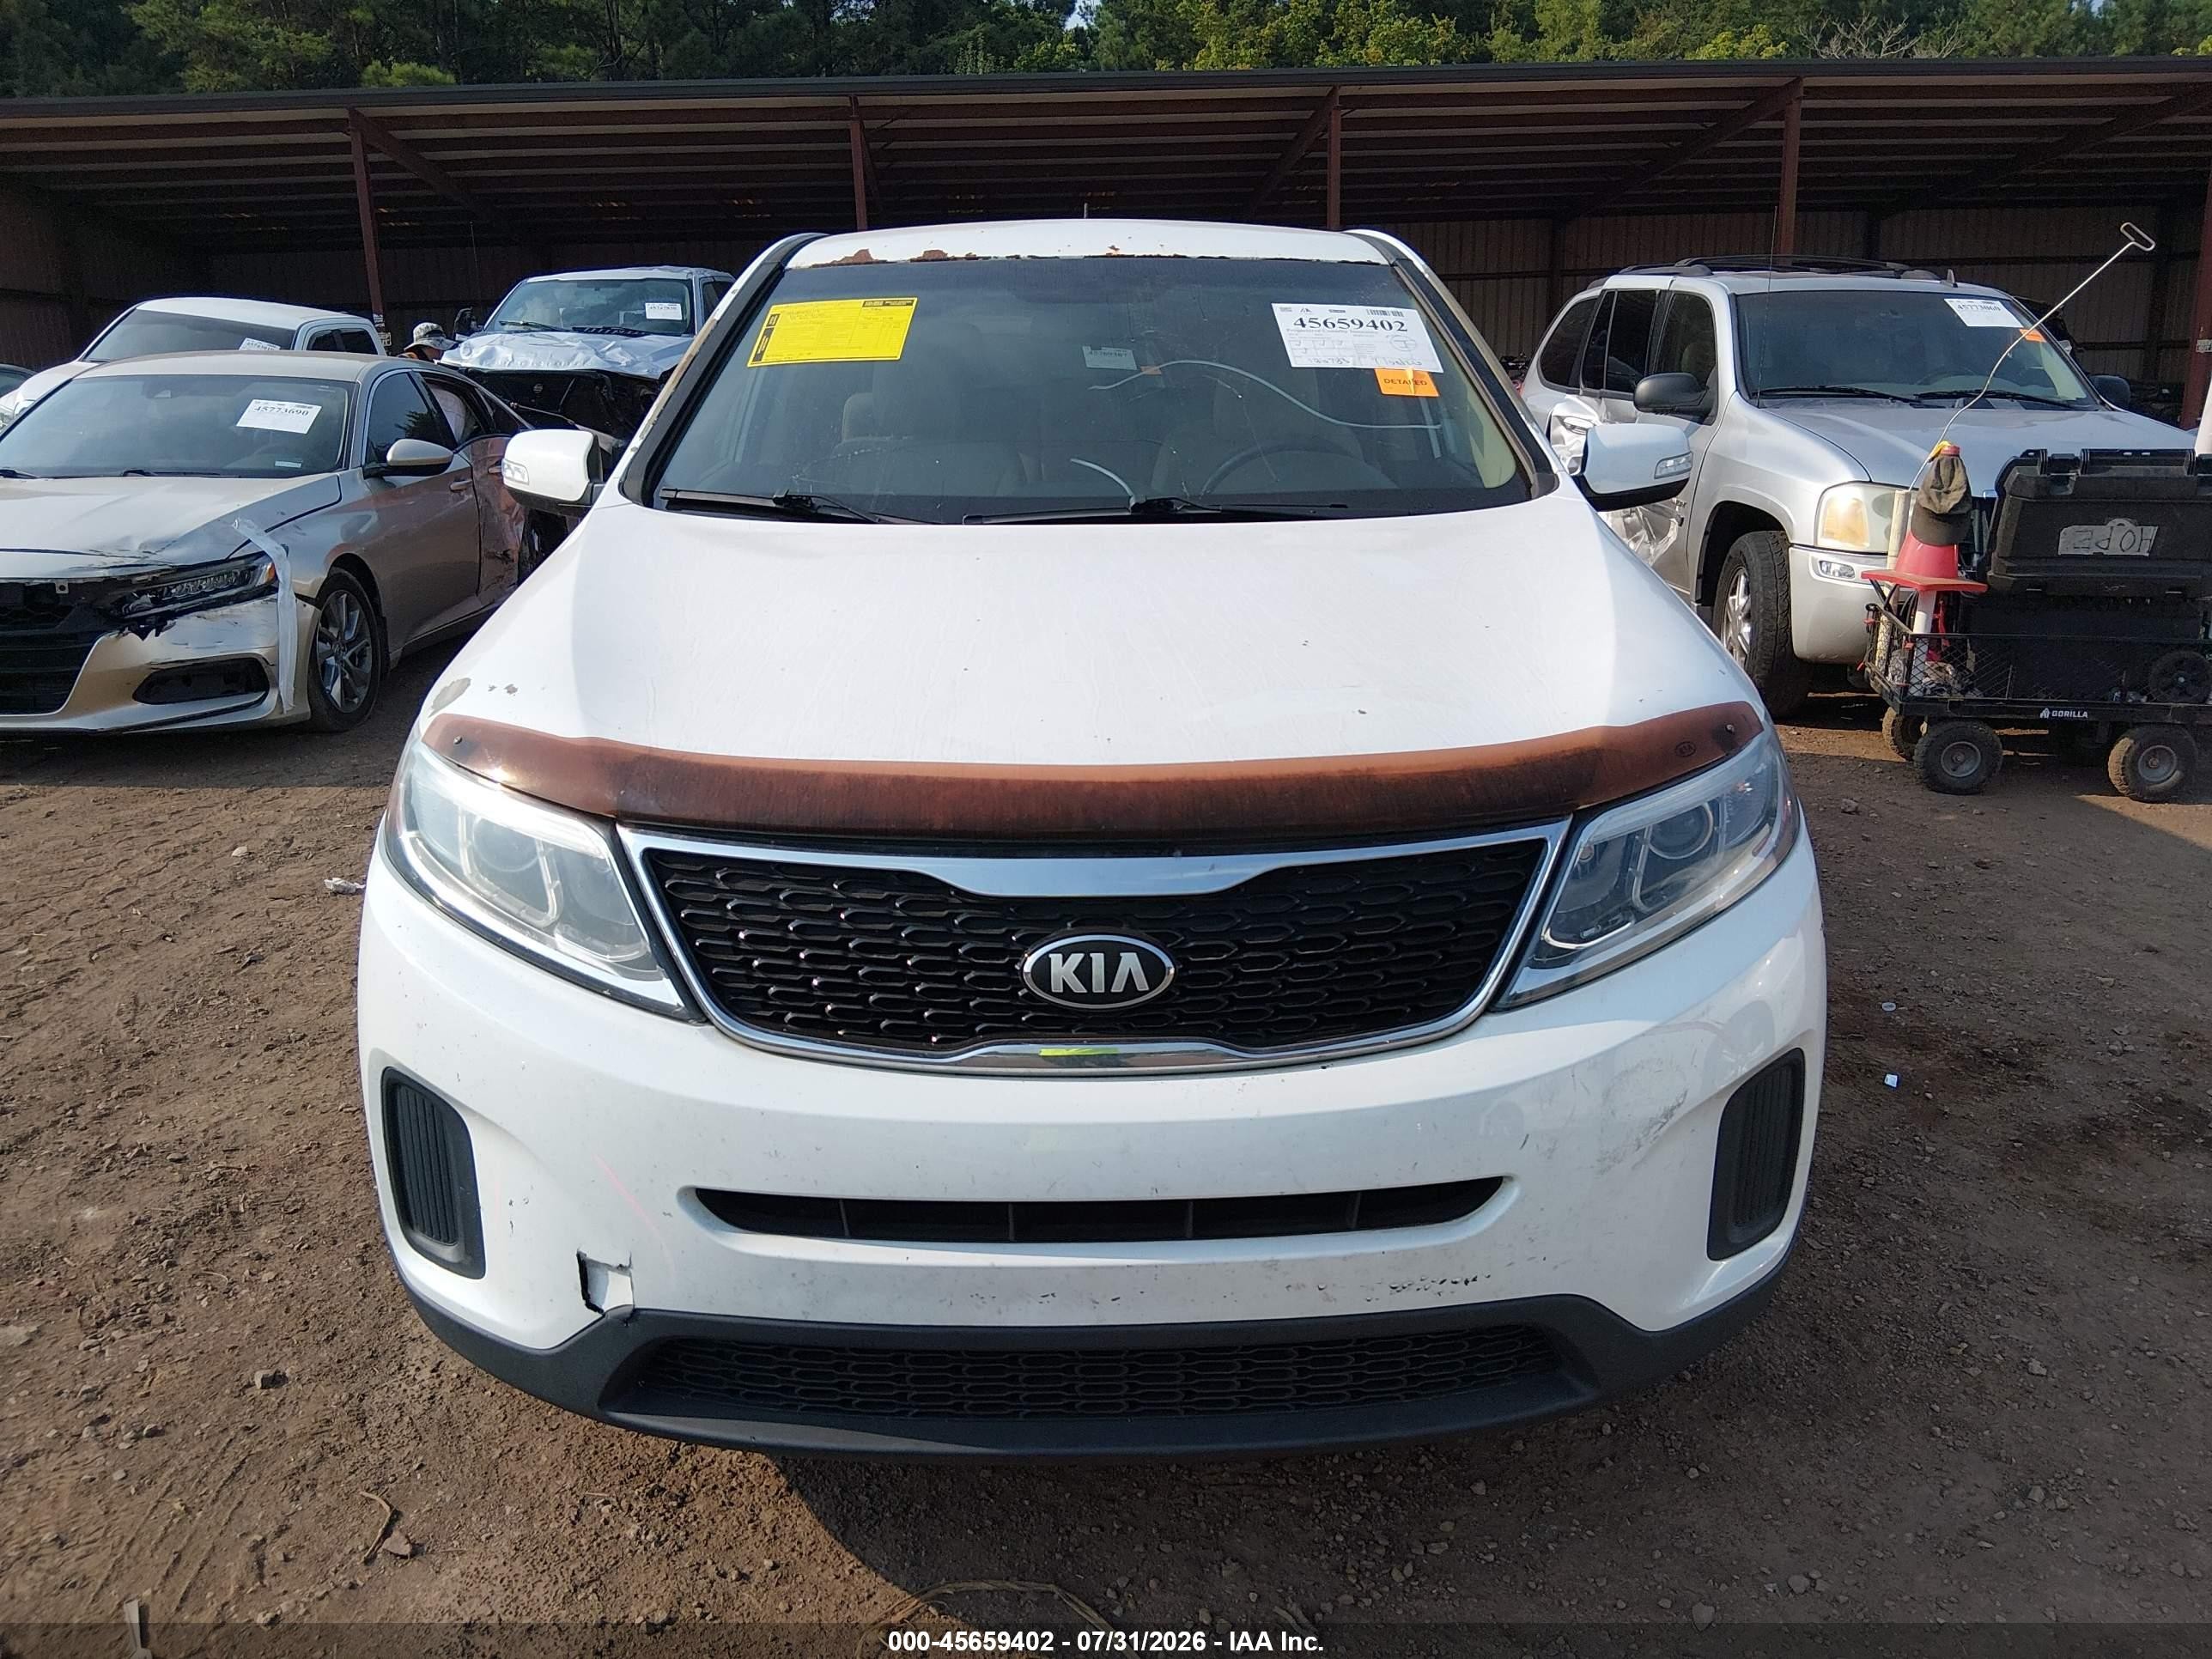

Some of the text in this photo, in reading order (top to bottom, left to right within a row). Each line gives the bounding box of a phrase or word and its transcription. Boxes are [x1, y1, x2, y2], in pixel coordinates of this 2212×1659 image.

[1293, 317, 1408, 332] 45659402
[2073, 525, 2154, 553] HOPE
[2051, 709, 2088, 719] GORILLA
[1048, 952, 1149, 993] KIA
